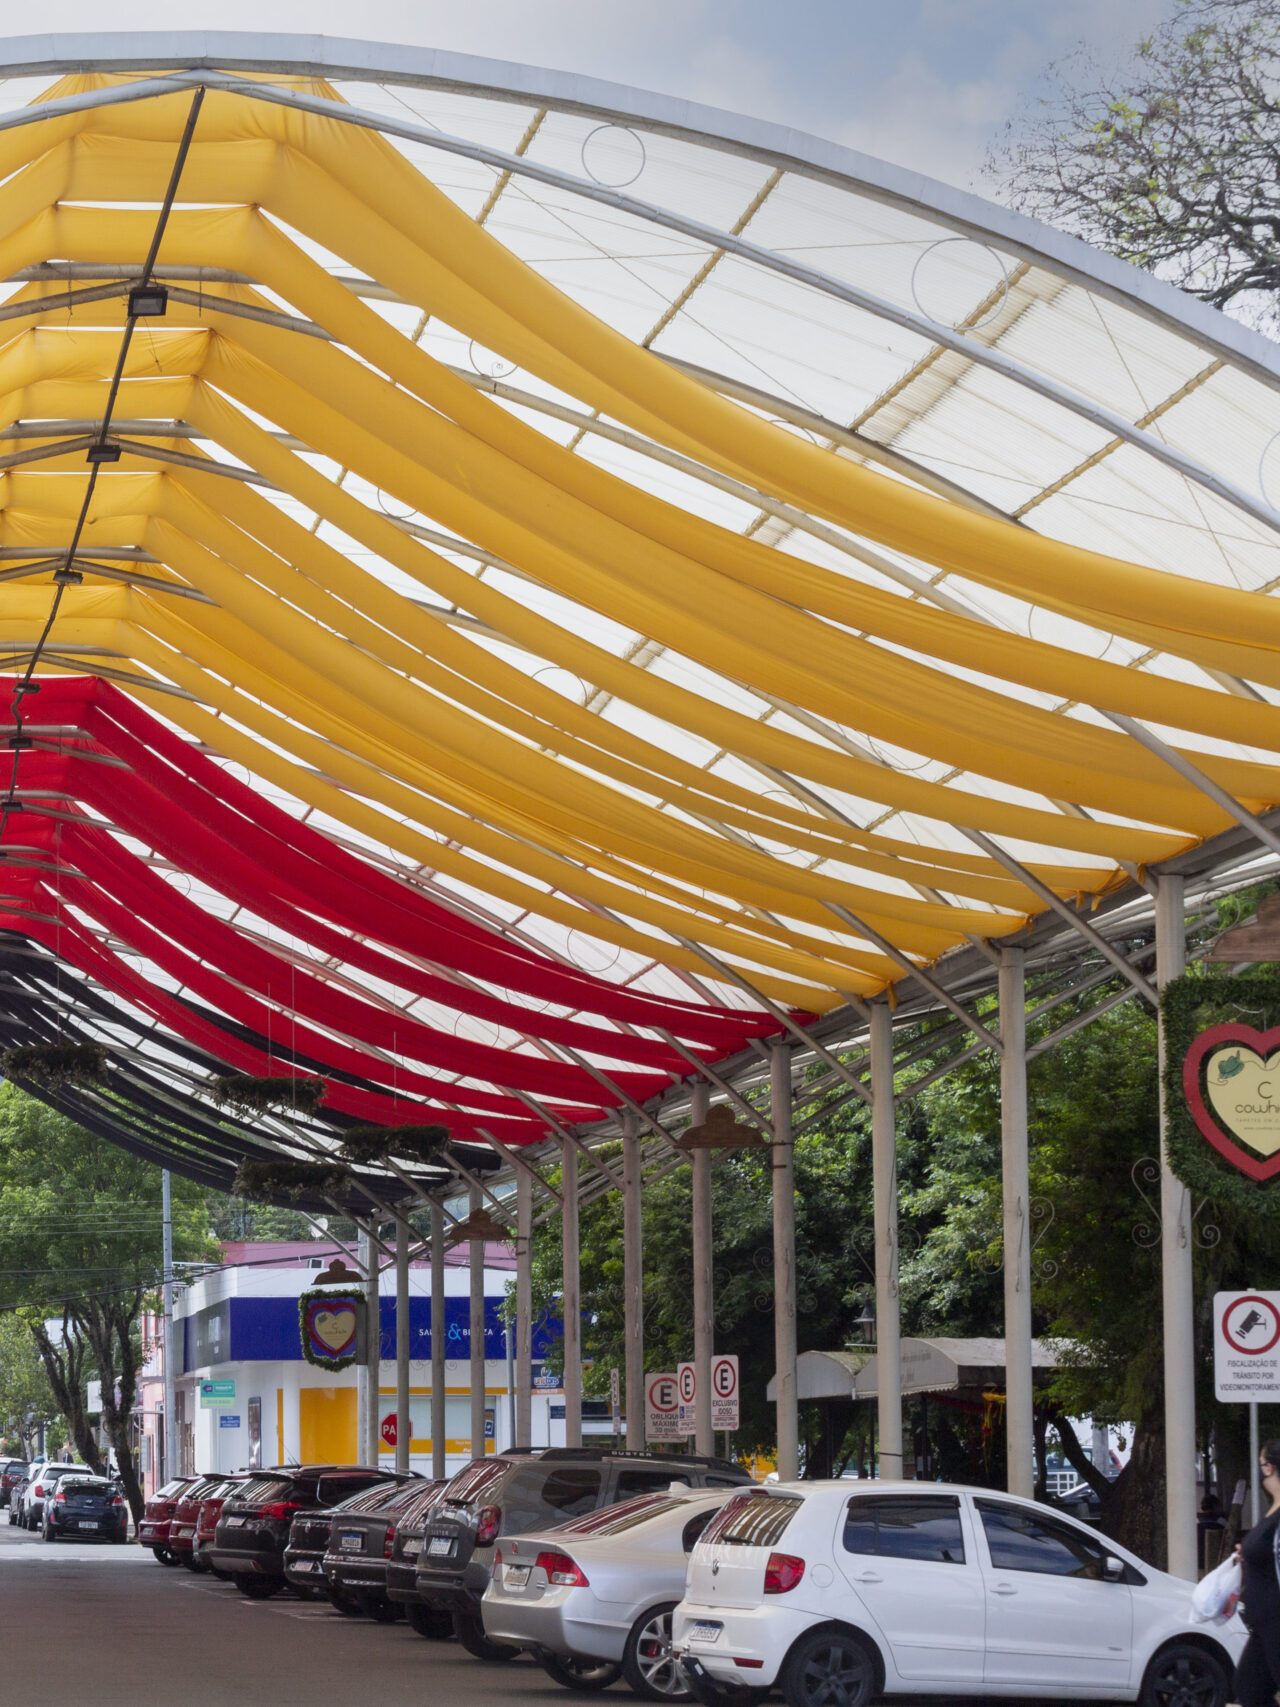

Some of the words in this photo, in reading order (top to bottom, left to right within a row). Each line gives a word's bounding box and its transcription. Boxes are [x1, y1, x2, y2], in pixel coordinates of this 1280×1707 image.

[1257, 1081, 1273, 1099] C
[448, 1323, 461, 1340] &
[685, 1374, 691, 1395] E
[720, 1368, 729, 1390] E
[660, 1385, 673, 1404] E
[712, 1399, 738, 1407] EXCLUSIVO
[718, 1407, 733, 1415] IDOSO
